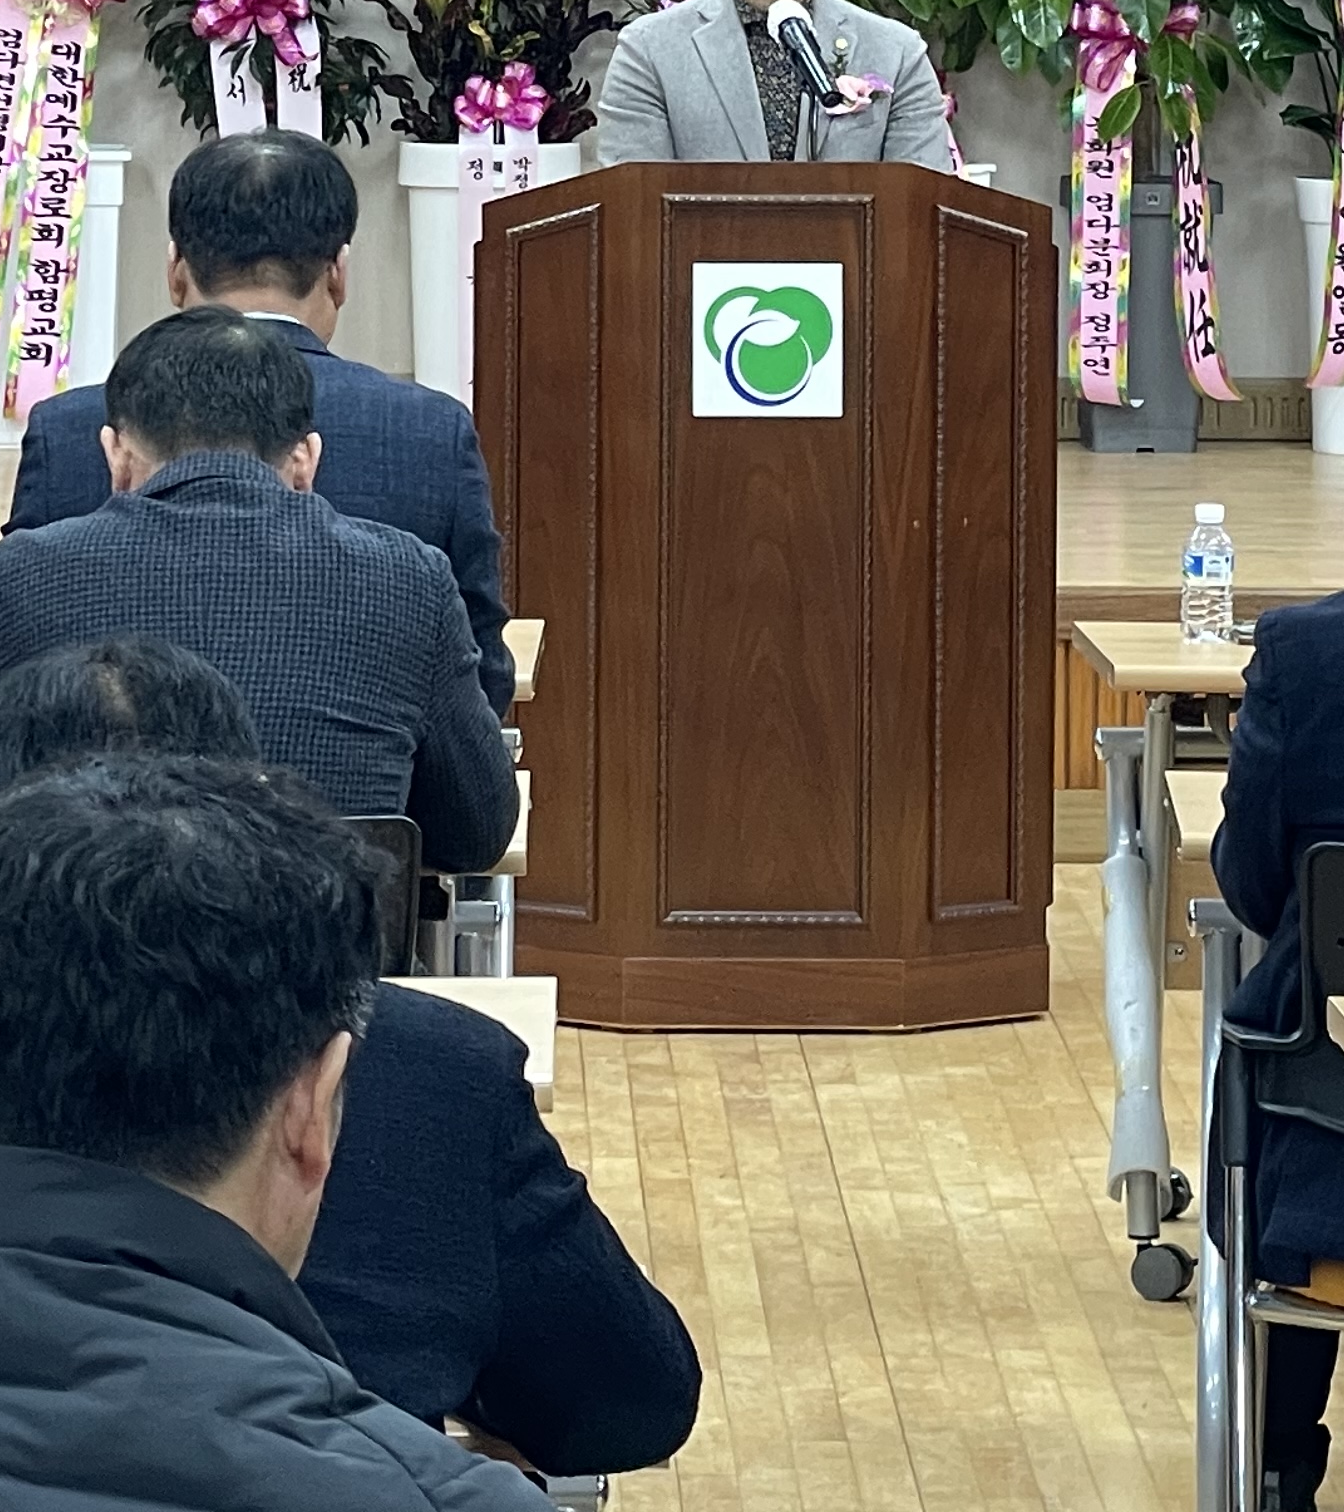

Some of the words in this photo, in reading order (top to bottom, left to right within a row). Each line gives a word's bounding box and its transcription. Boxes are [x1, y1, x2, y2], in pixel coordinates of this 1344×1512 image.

[30, 41, 86, 249] 대한예수교장로회
[1085, 116, 1123, 178] 화원
[19, 258, 70, 368] 함평교회
